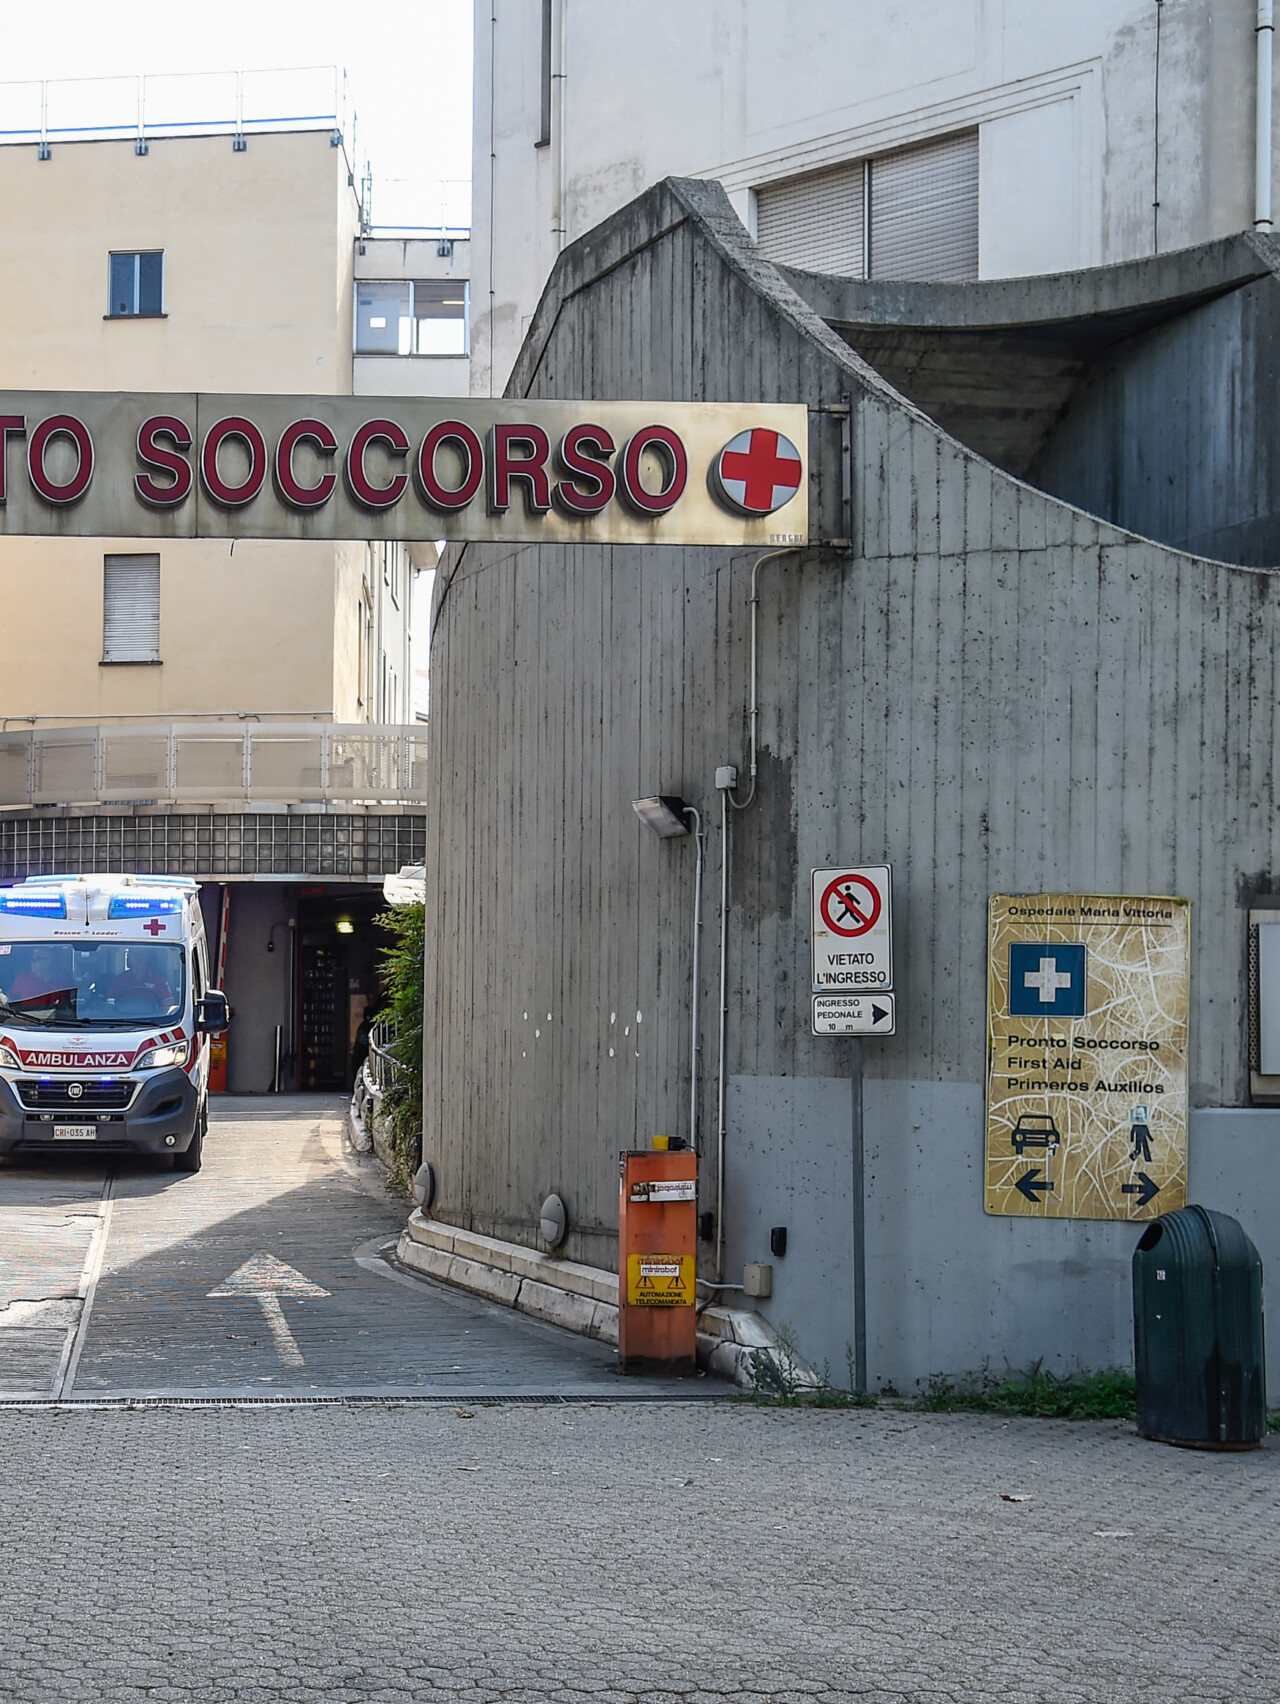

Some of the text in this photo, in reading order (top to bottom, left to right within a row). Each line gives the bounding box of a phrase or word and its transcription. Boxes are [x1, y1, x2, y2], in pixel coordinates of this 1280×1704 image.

[134, 416, 689, 514] SOCCORSO
[1008, 906, 1173, 919] Ospedale Maria Vittoria
[827, 953, 875, 966] VIETATO
[817, 971, 887, 984] L'INGRESSO
[817, 999, 860, 1008] INGRESSO
[817, 1011, 863, 1019] PEDONALE
[828, 1023, 836, 1031] 10
[1008, 1036, 1160, 1050] Pronto Soccorso
[25, 1052, 128, 1066] AMBULANZA
[1008, 1057, 1082, 1070] First Aid
[1007, 1078, 1164, 1094] Primeros Auxilios
[70, 1128, 84, 1137] 035
